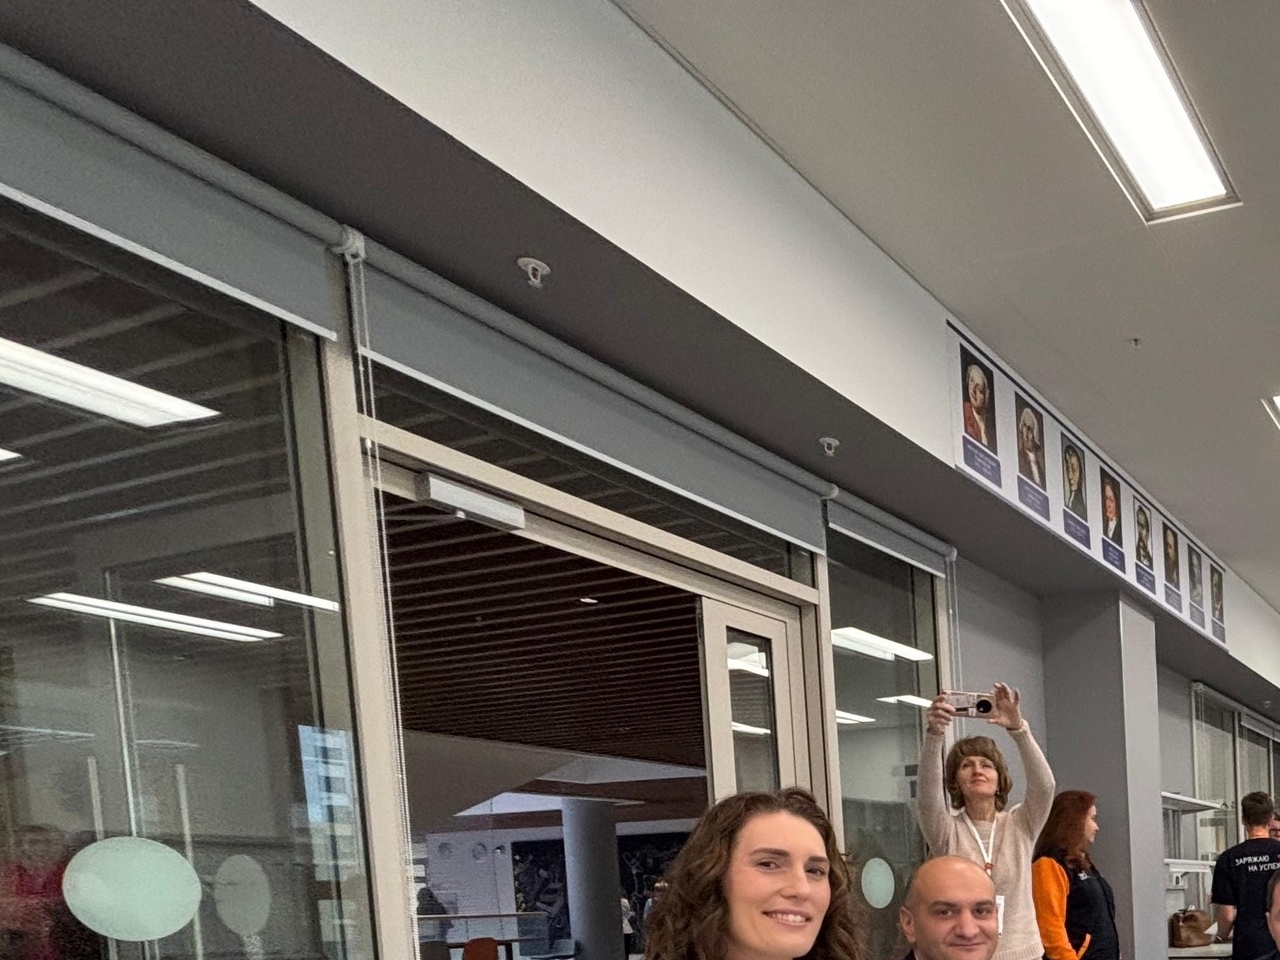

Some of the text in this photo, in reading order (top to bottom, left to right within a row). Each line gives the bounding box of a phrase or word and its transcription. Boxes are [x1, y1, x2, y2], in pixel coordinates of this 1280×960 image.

[1235, 855, 1269, 866] ЗАРЯЖАЮ
[1248, 862, 1280, 872] НА УСПЕХ
